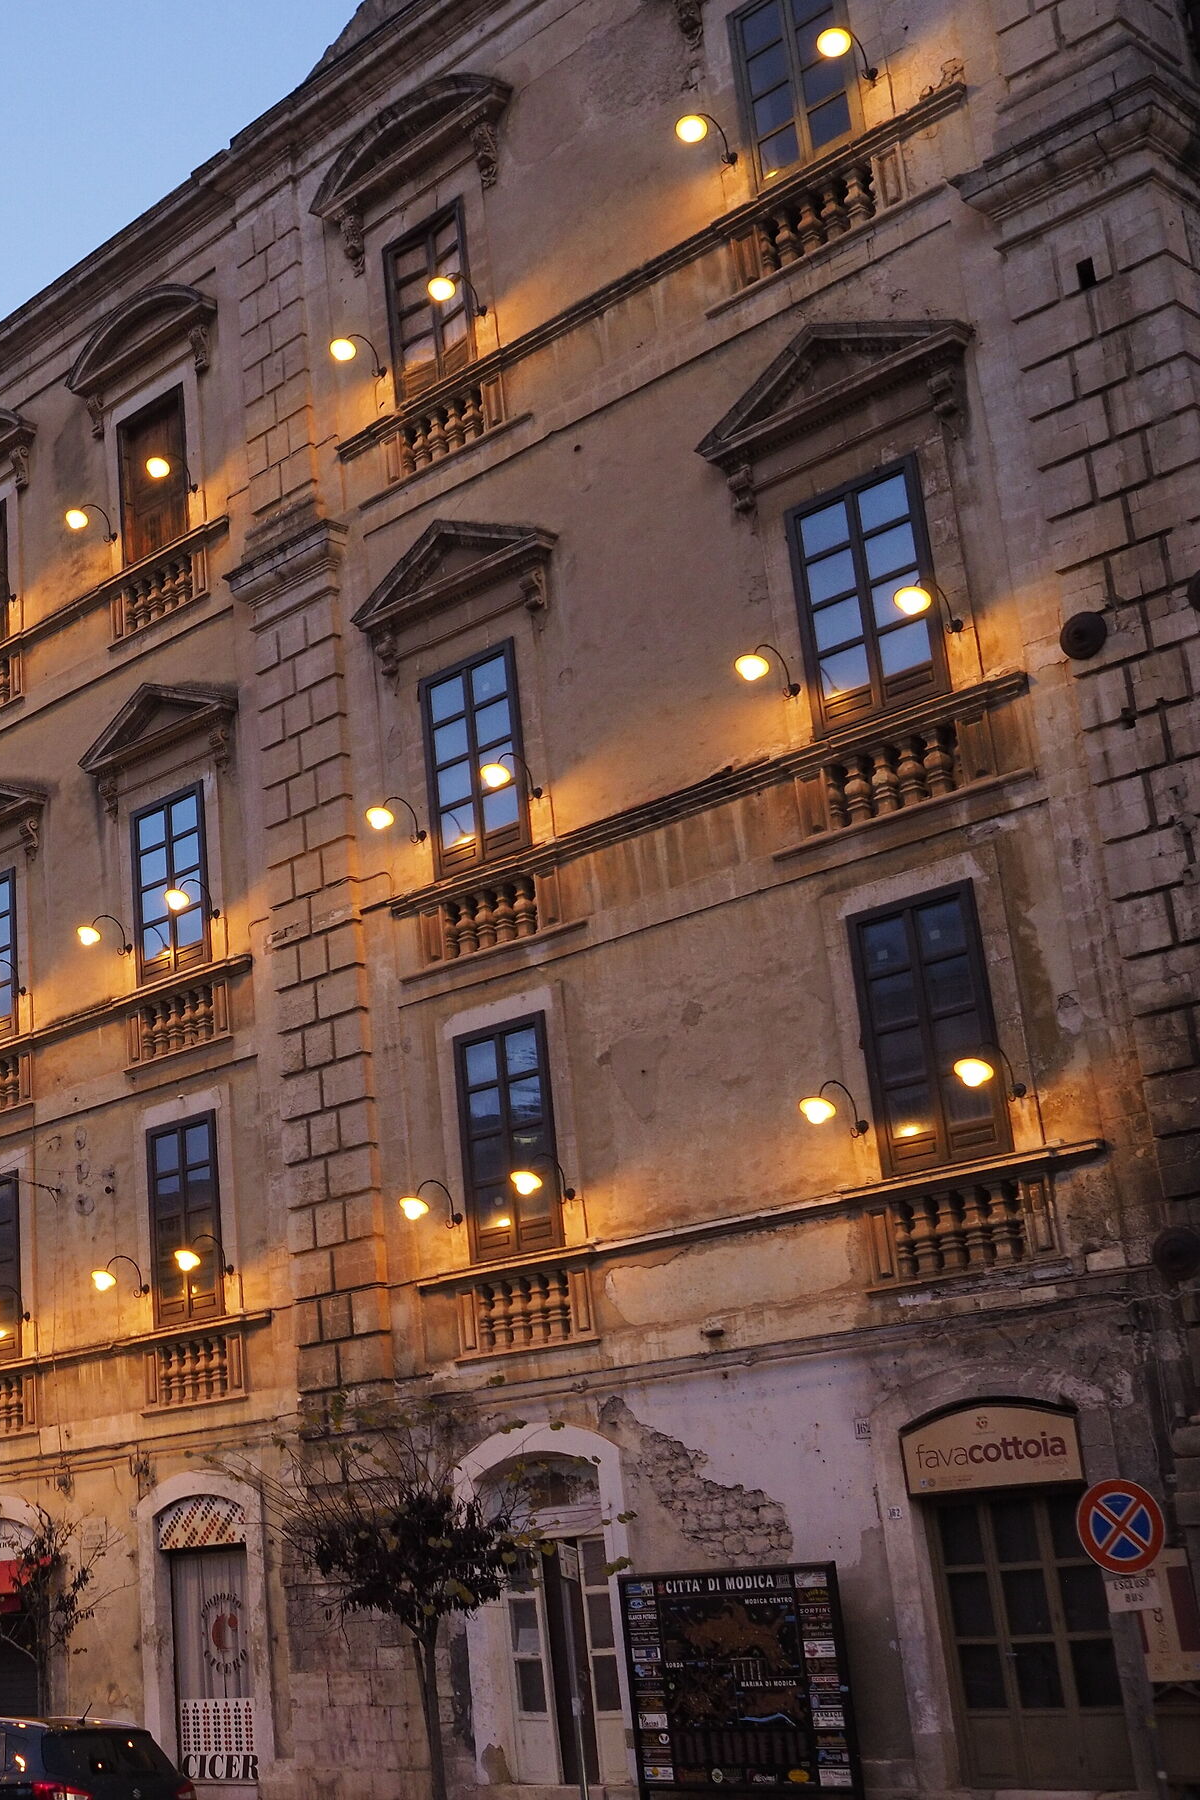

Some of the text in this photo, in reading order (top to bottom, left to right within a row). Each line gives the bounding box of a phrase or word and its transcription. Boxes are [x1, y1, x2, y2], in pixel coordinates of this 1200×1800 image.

[915, 1431, 1067, 1469] favacottoia
[708, 1577, 721, 1592] DI
[725, 1574, 775, 1591] MODICA
[768, 1596, 793, 1604] CENTRO
[1125, 1593, 1144, 1603] BUS
[204, 1649, 248, 1675] CICERO
[773, 1679, 797, 1687] MODICA
[183, 1754, 259, 1780] CICER
